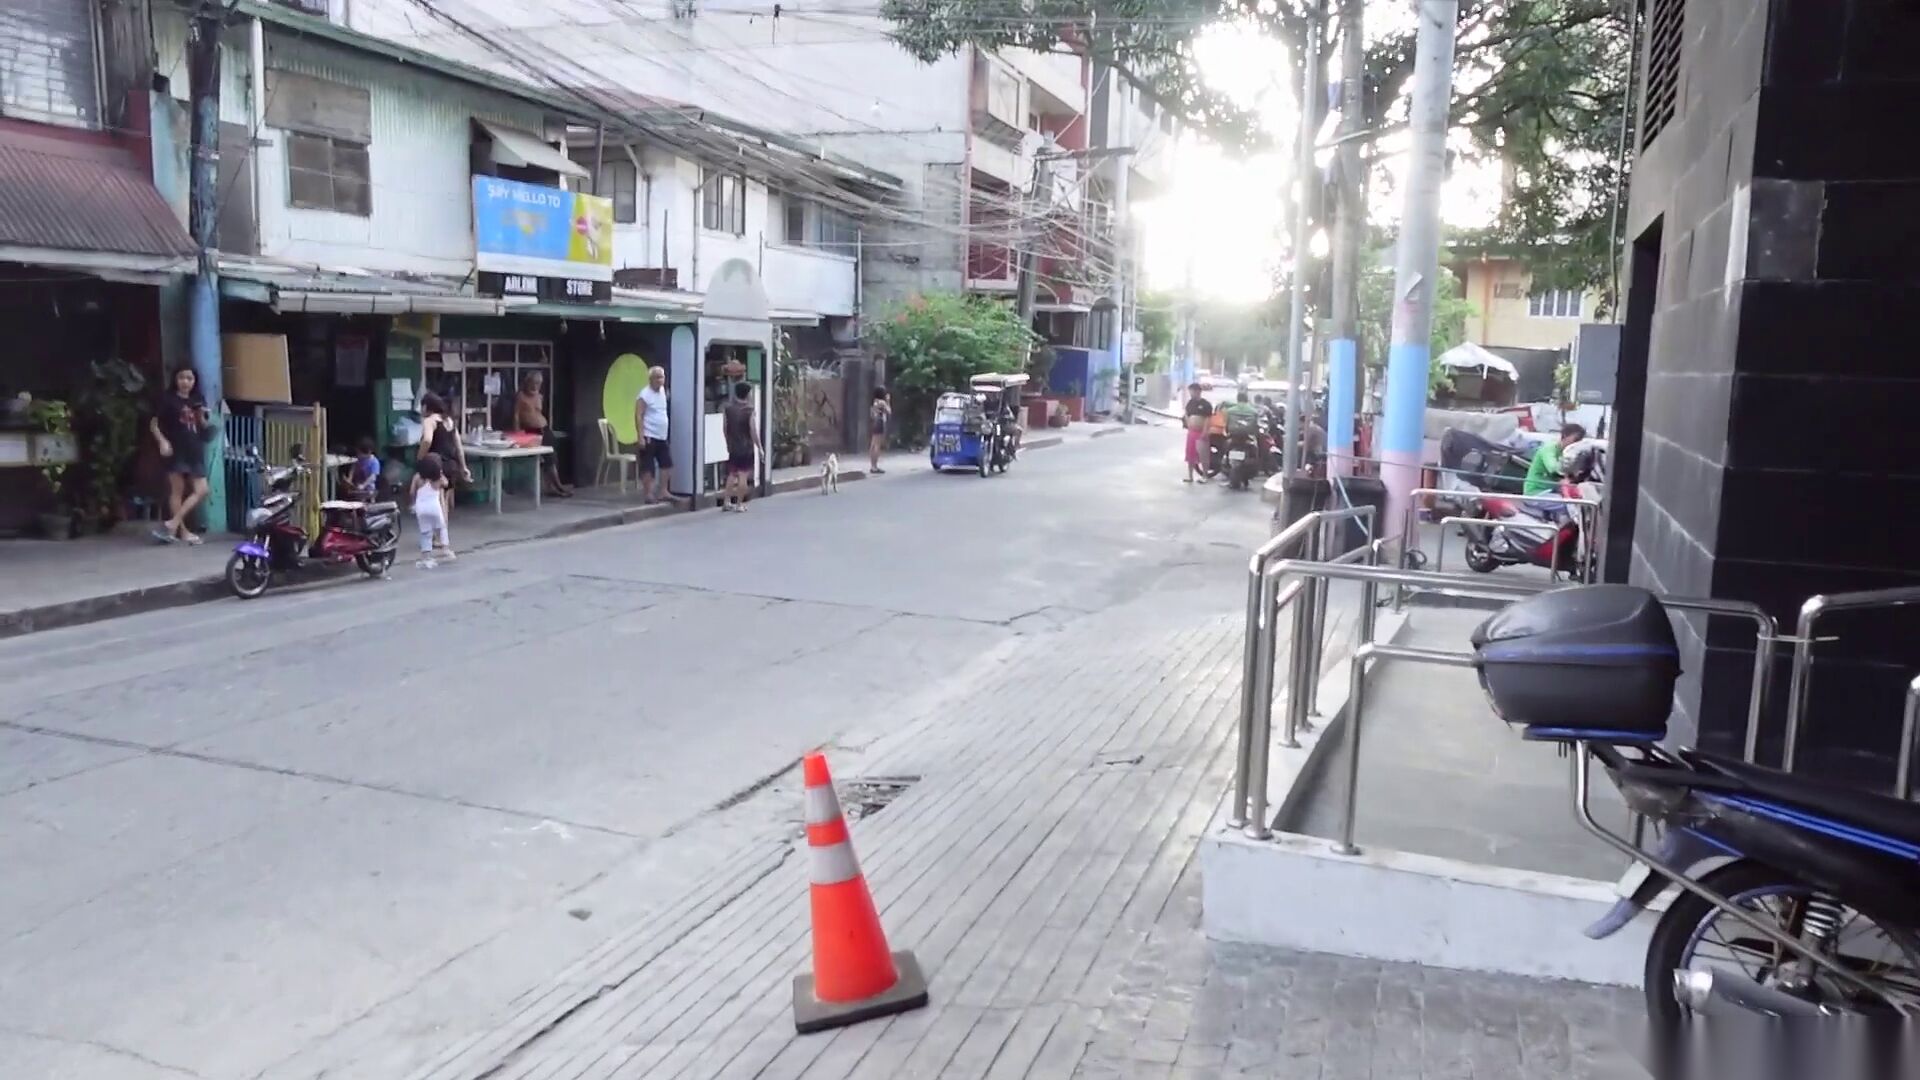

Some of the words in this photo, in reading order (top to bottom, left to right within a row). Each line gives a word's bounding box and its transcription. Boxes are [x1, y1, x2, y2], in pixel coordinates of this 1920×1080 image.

[488, 184, 509, 199] SAY
[512, 188, 546, 205] HELLO
[547, 195, 561, 209] TO
[566, 279, 593, 296] STORE
[1134, 377, 1145, 393] P
